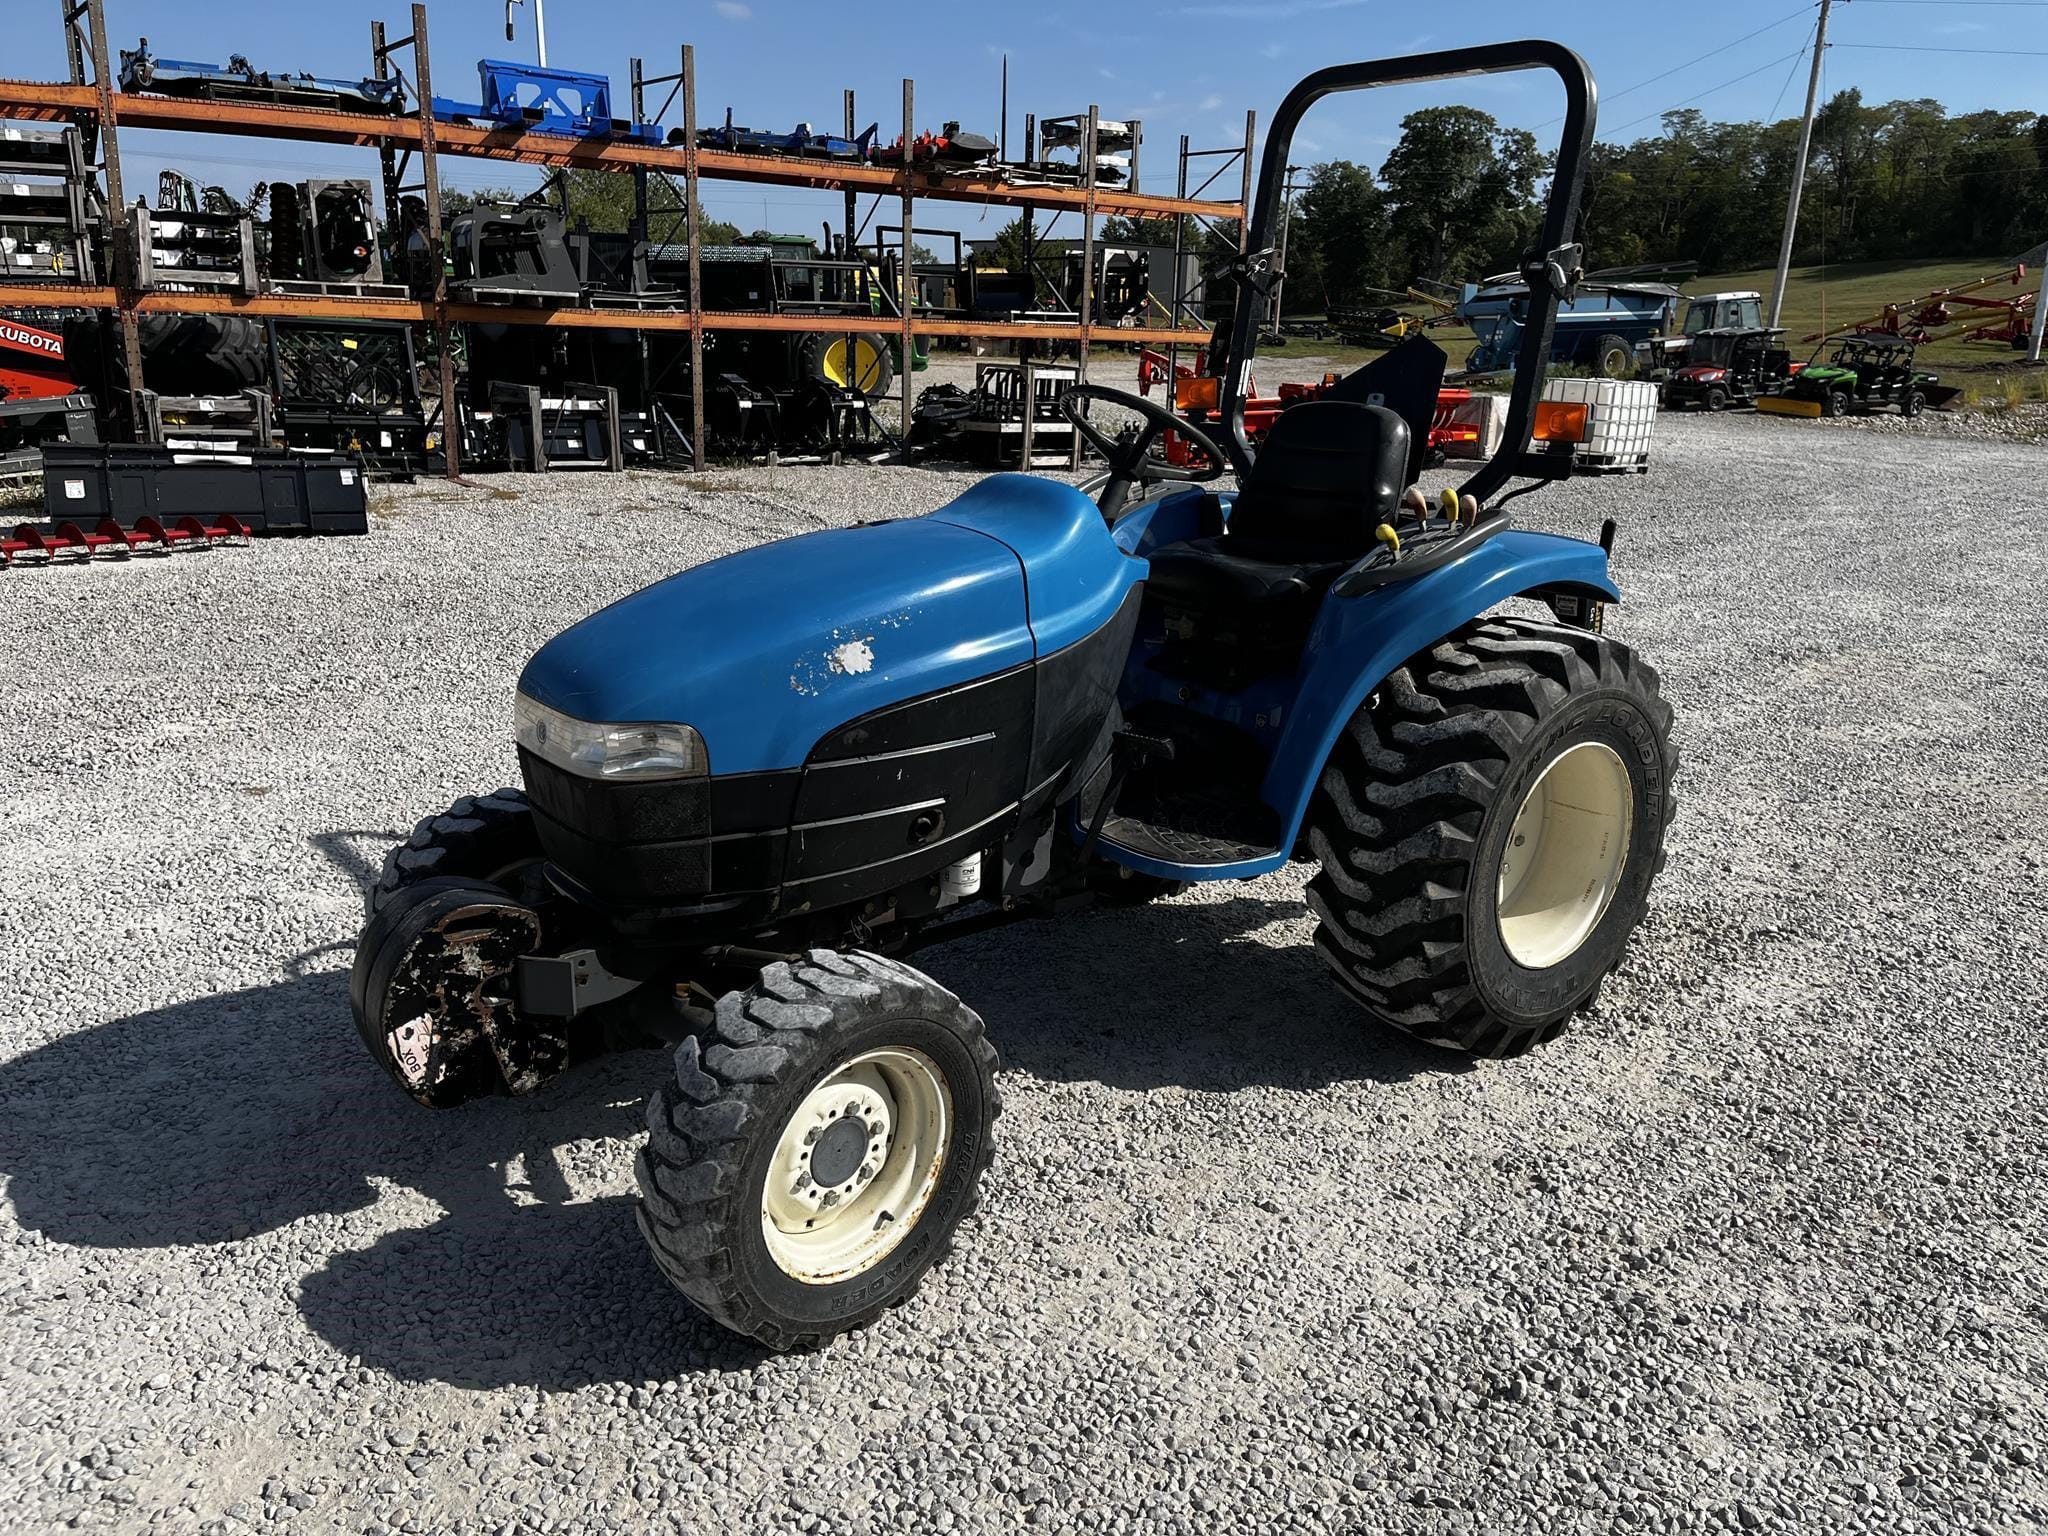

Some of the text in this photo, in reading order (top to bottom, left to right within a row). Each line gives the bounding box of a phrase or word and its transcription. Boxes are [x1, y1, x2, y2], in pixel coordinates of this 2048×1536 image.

[1594, 704, 1660, 818] LOADER
[402, 1048, 421, 1073] BOX
[830, 1131, 976, 1312] TRAC LOADER
